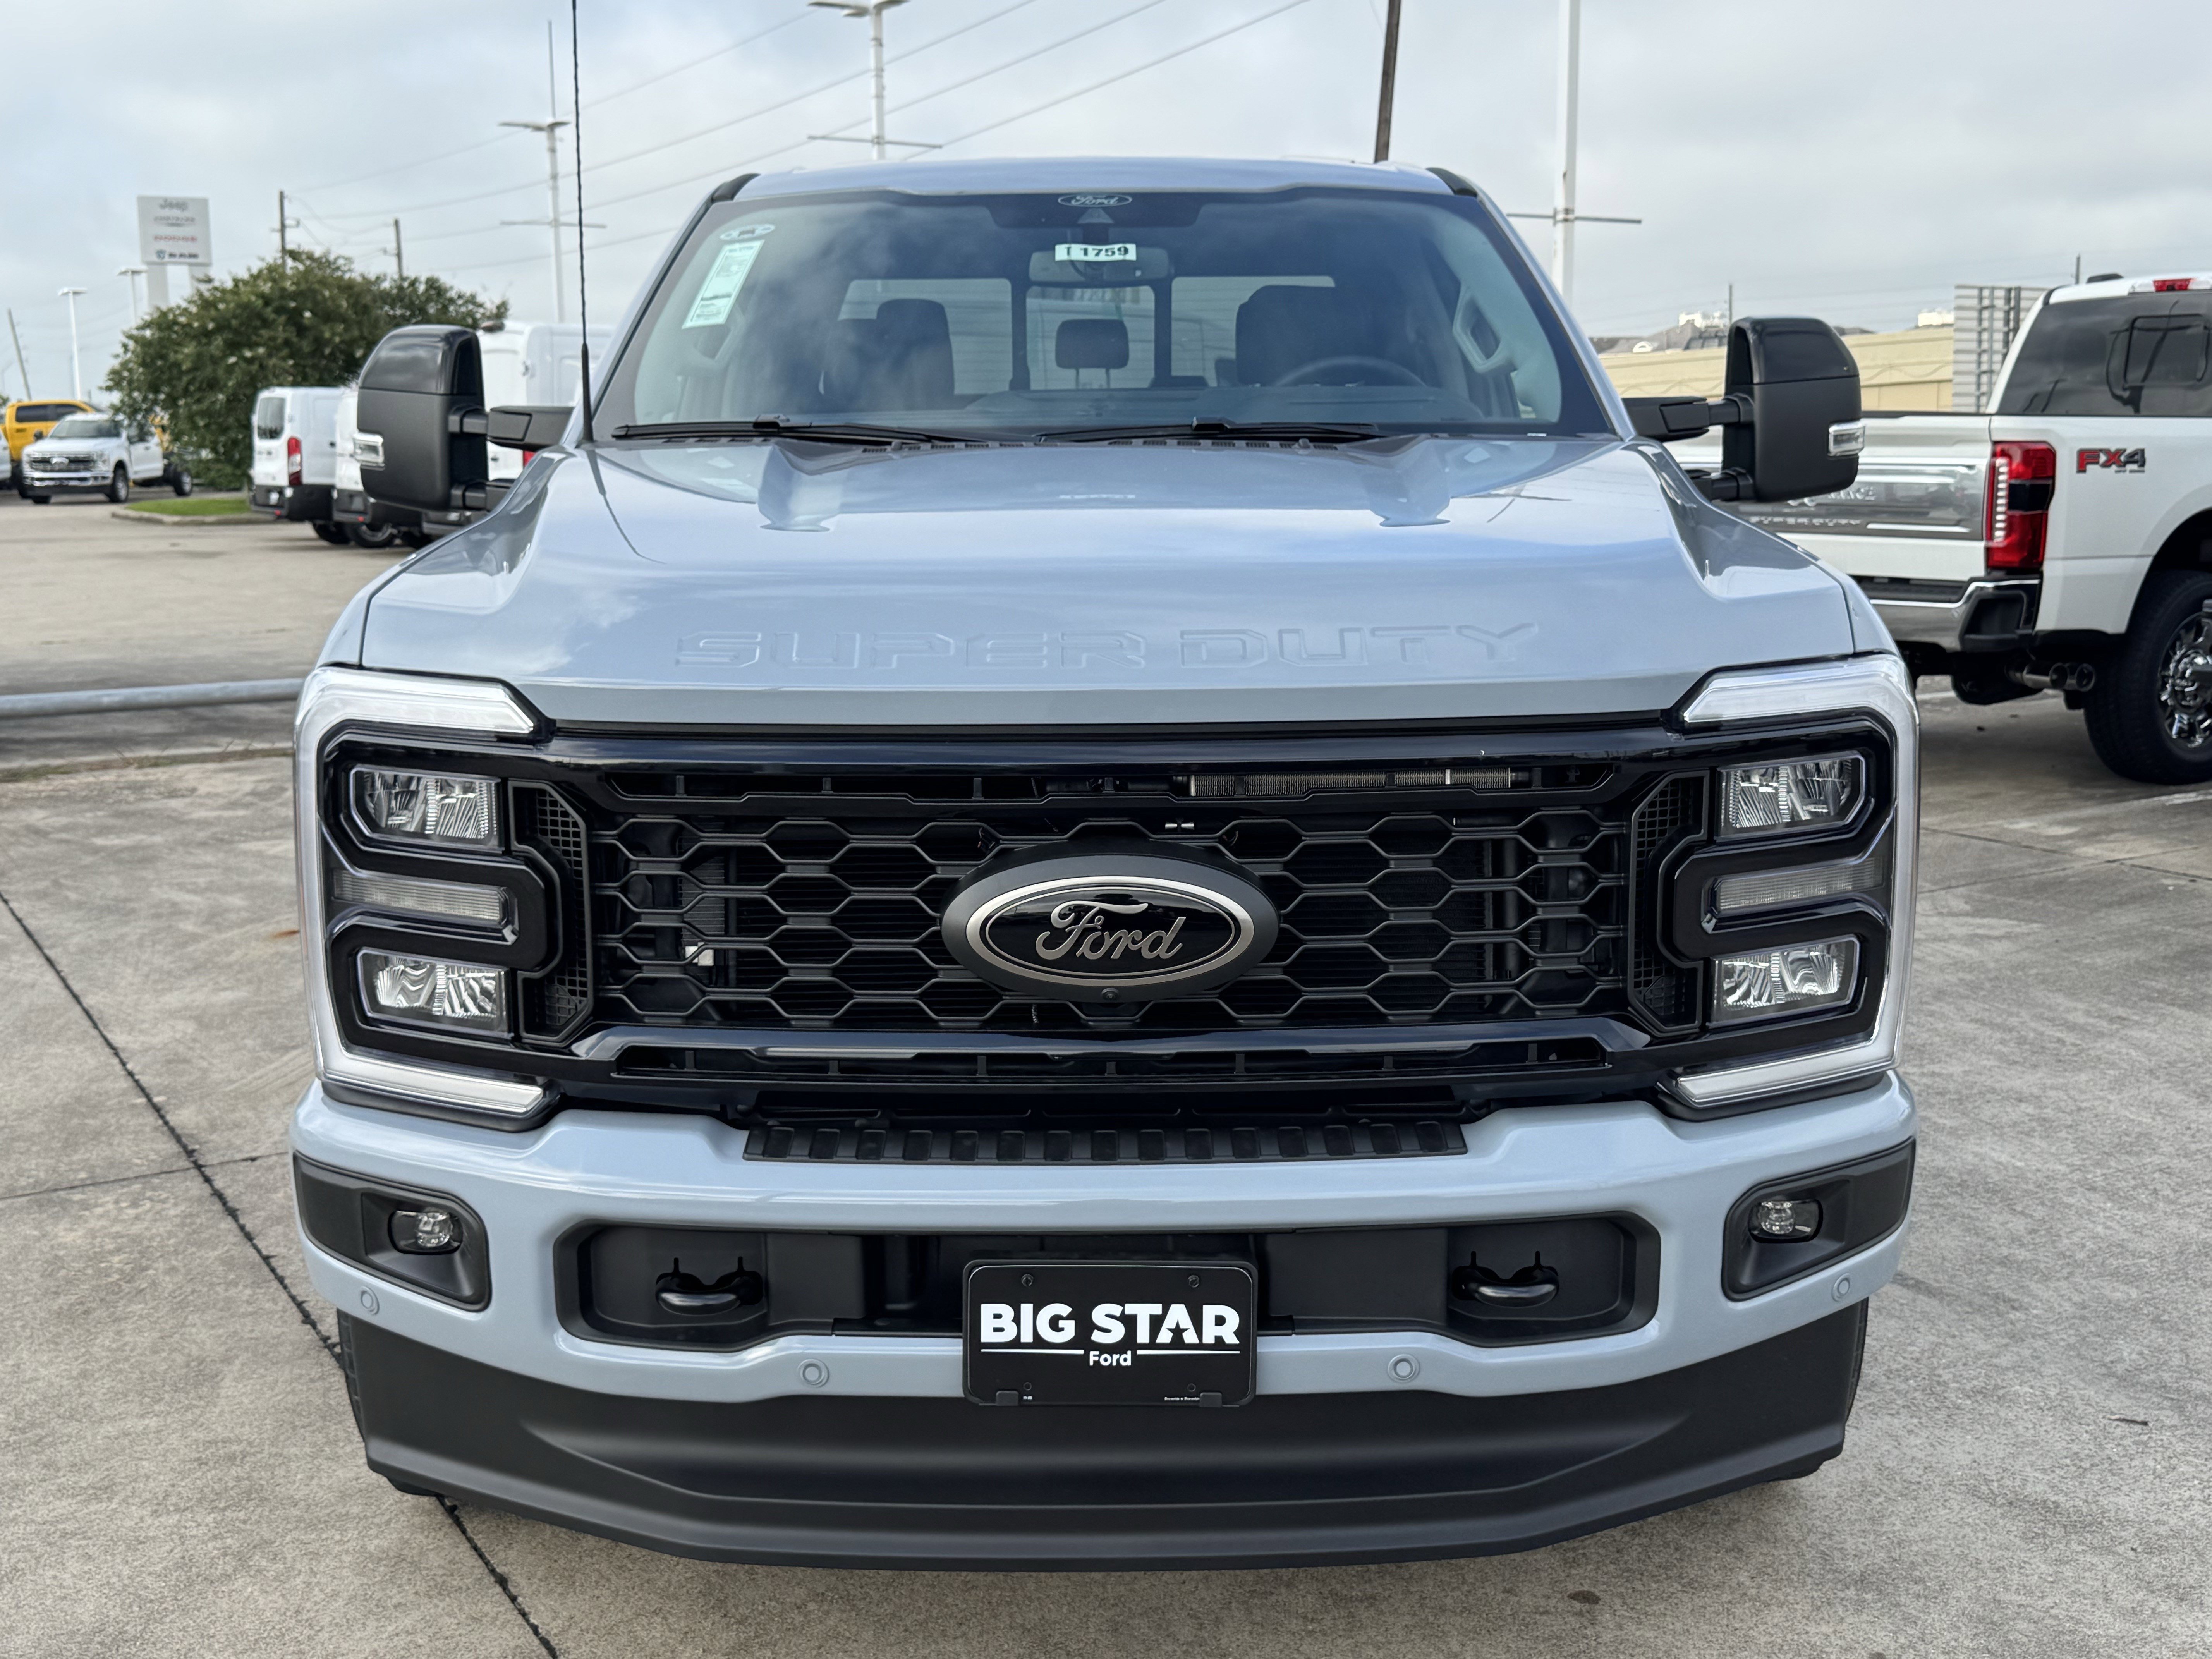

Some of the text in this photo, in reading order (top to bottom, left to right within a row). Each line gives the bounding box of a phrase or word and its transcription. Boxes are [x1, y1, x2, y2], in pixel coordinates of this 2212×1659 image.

[1071, 196, 1118, 204] Ford
[2076, 448, 2146, 474] FX4
[675, 622, 1538, 669] SUPER DUTY
[1035, 900, 1187, 960] Ford
[981, 1303, 1240, 1344] BIG STAR
[1089, 1350, 1132, 1366] Ford
